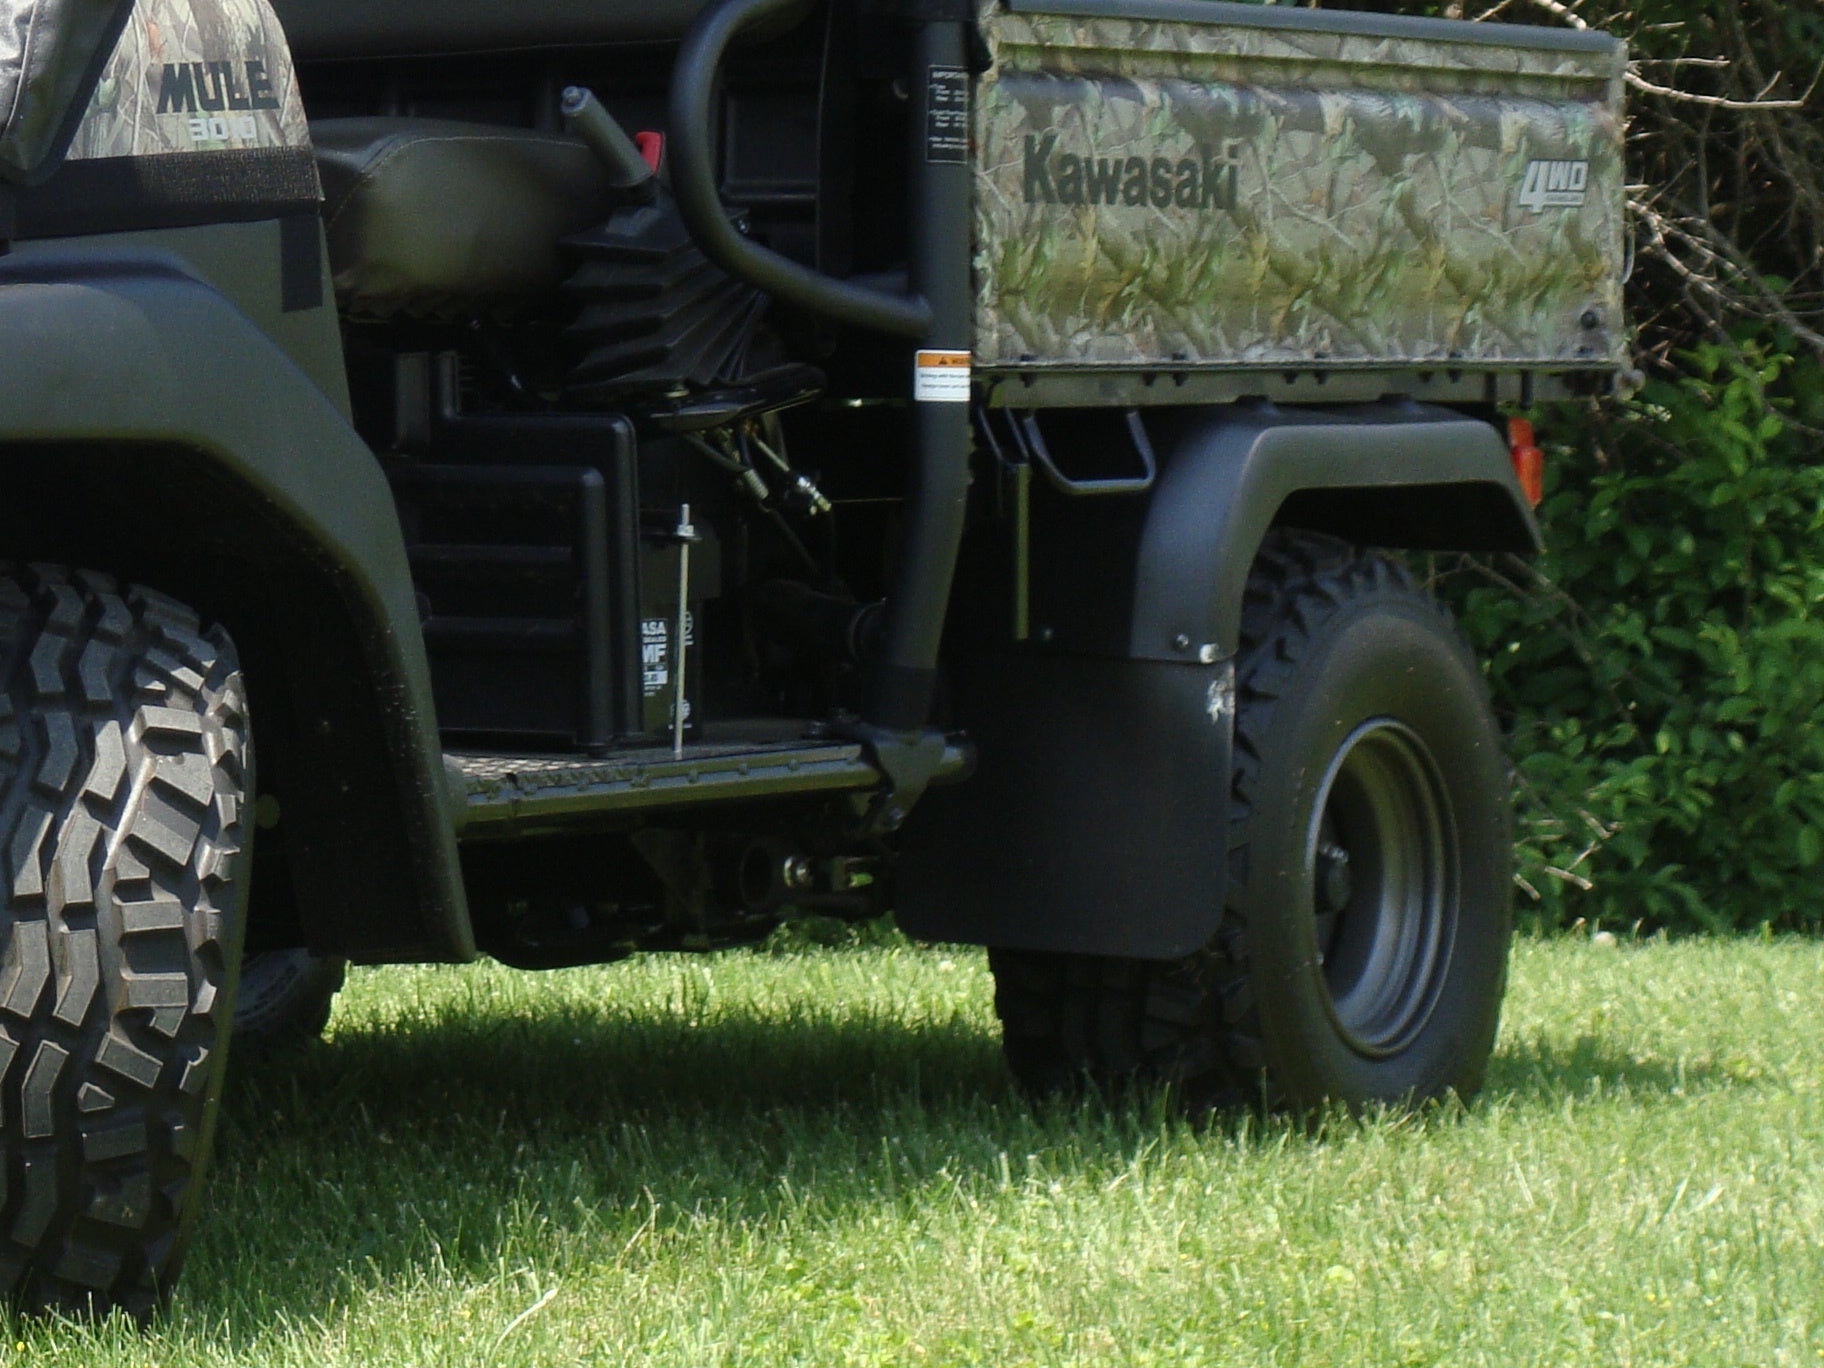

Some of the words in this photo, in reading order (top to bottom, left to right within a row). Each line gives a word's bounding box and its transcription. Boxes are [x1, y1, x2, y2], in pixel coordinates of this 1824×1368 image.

[157, 61, 280, 113] MULE
[189, 116, 257, 141] 3010
[1024, 134, 1238, 209] Kawasaki
[1520, 160, 1588, 212] 4WD
[642, 621, 667, 635] ASA
